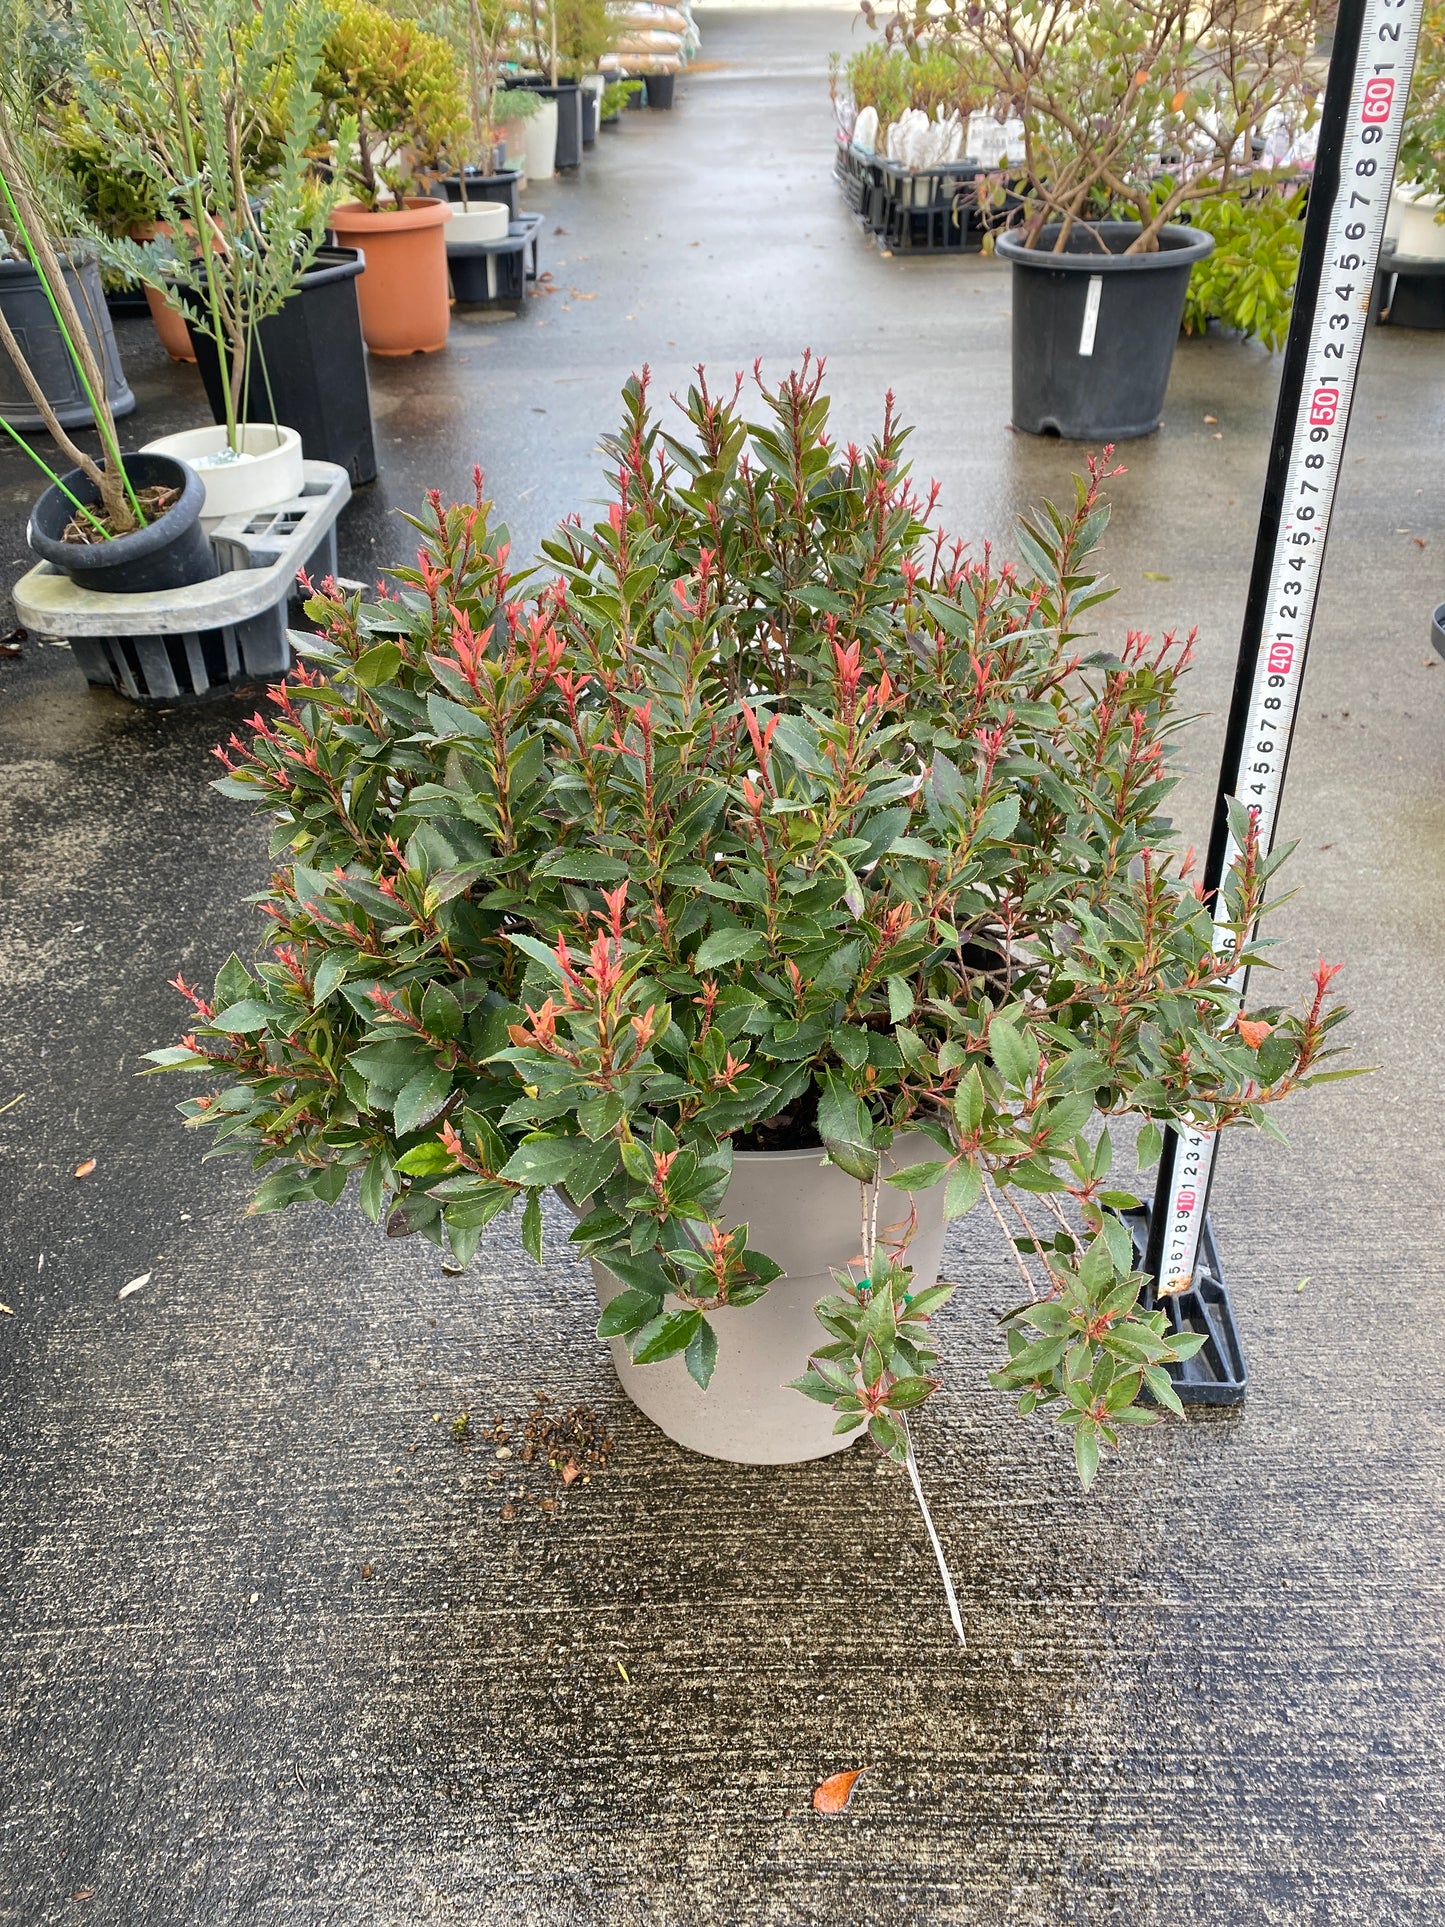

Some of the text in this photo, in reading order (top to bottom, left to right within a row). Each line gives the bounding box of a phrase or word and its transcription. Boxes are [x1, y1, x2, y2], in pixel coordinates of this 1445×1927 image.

[1379, 22, 1402, 41] 2
[1374, 63, 1394, 75] 1
[1365, 83, 1392, 117] 60
[1361, 125, 1383, 144] 9
[1356, 159, 1377, 177] 8
[1350, 191, 1371, 208] 7
[1345, 222, 1366, 240] 6
[1340, 254, 1360, 270] 5
[1335, 283, 1355, 301] 4
[1329, 313, 1349, 330] 3
[1324, 343, 1345, 358] 2
[1320, 376, 1339, 386] 1
[1313, 393, 1337, 420] 50
[1310, 427, 1329, 442] 9
[1305, 454, 1324, 469] 8
[1300, 480, 1319, 495] 7
[1296, 506, 1315, 520] 6
[1292, 532, 1311, 546] 5
[1289, 557, 1306, 571] 4
[1284, 581, 1301, 595] 3
[1280, 605, 1298, 619] 2
[1277, 632, 1293, 641] 1
[1272, 646, 1292, 670] 40
[1268, 675, 1285, 688] 9
[1264, 697, 1282, 710] 8
[1260, 719, 1277, 731] 7
[1257, 741, 1274, 753] 6
[1253, 762, 1270, 774] 5
[1250, 783, 1266, 795] 4
[1223, 938, 1236, 948] 6
[1189, 1137, 1202, 1146] 4
[1186, 1152, 1200, 1160] 3
[1184, 1167, 1197, 1175] 2
[1178, 1192, 1194, 1207] 10
[1177, 1210, 1190, 1218] 9
[1171, 1252, 1183, 1260] 6
[1169, 1266, 1181, 1274] 5
